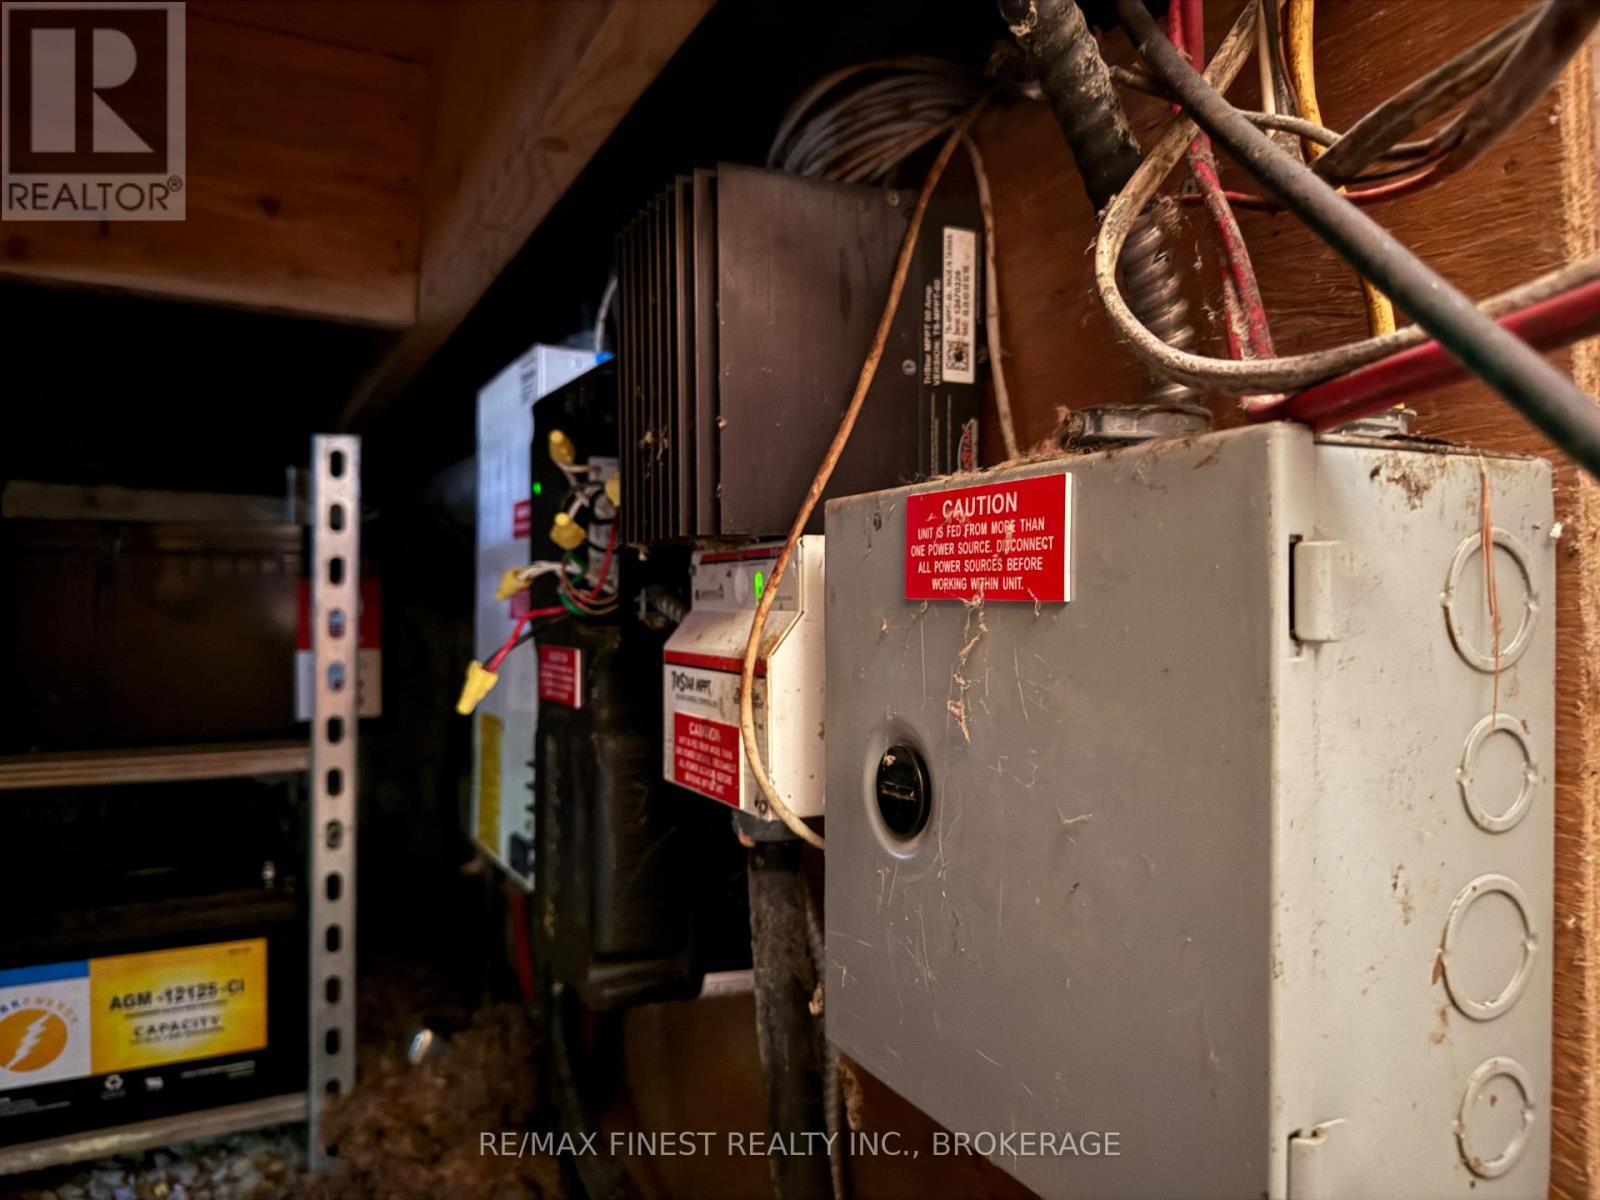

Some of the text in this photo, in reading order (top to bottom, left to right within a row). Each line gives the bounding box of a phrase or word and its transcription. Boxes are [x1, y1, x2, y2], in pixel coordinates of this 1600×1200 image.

[923, 285, 933, 384] TriStar MPPT 60 Amp
[932, 339, 941, 386] VERSION:
[942, 491, 1018, 519] CAUTION
[917, 517, 1045, 540] UNIT IS FED FROM MORE THAN
[911, 544, 926, 557] ONE
[928, 543, 955, 556] POWER
[957, 540, 992, 555] SOURCE.
[917, 557, 1044, 574] ALL POWER SOURCES BEFORE
[931, 576, 1025, 590] WORKING WITHIN UNIT.
[109, 991, 153, 1012] AGM
[133, 1015, 222, 1037] CAPACITY
